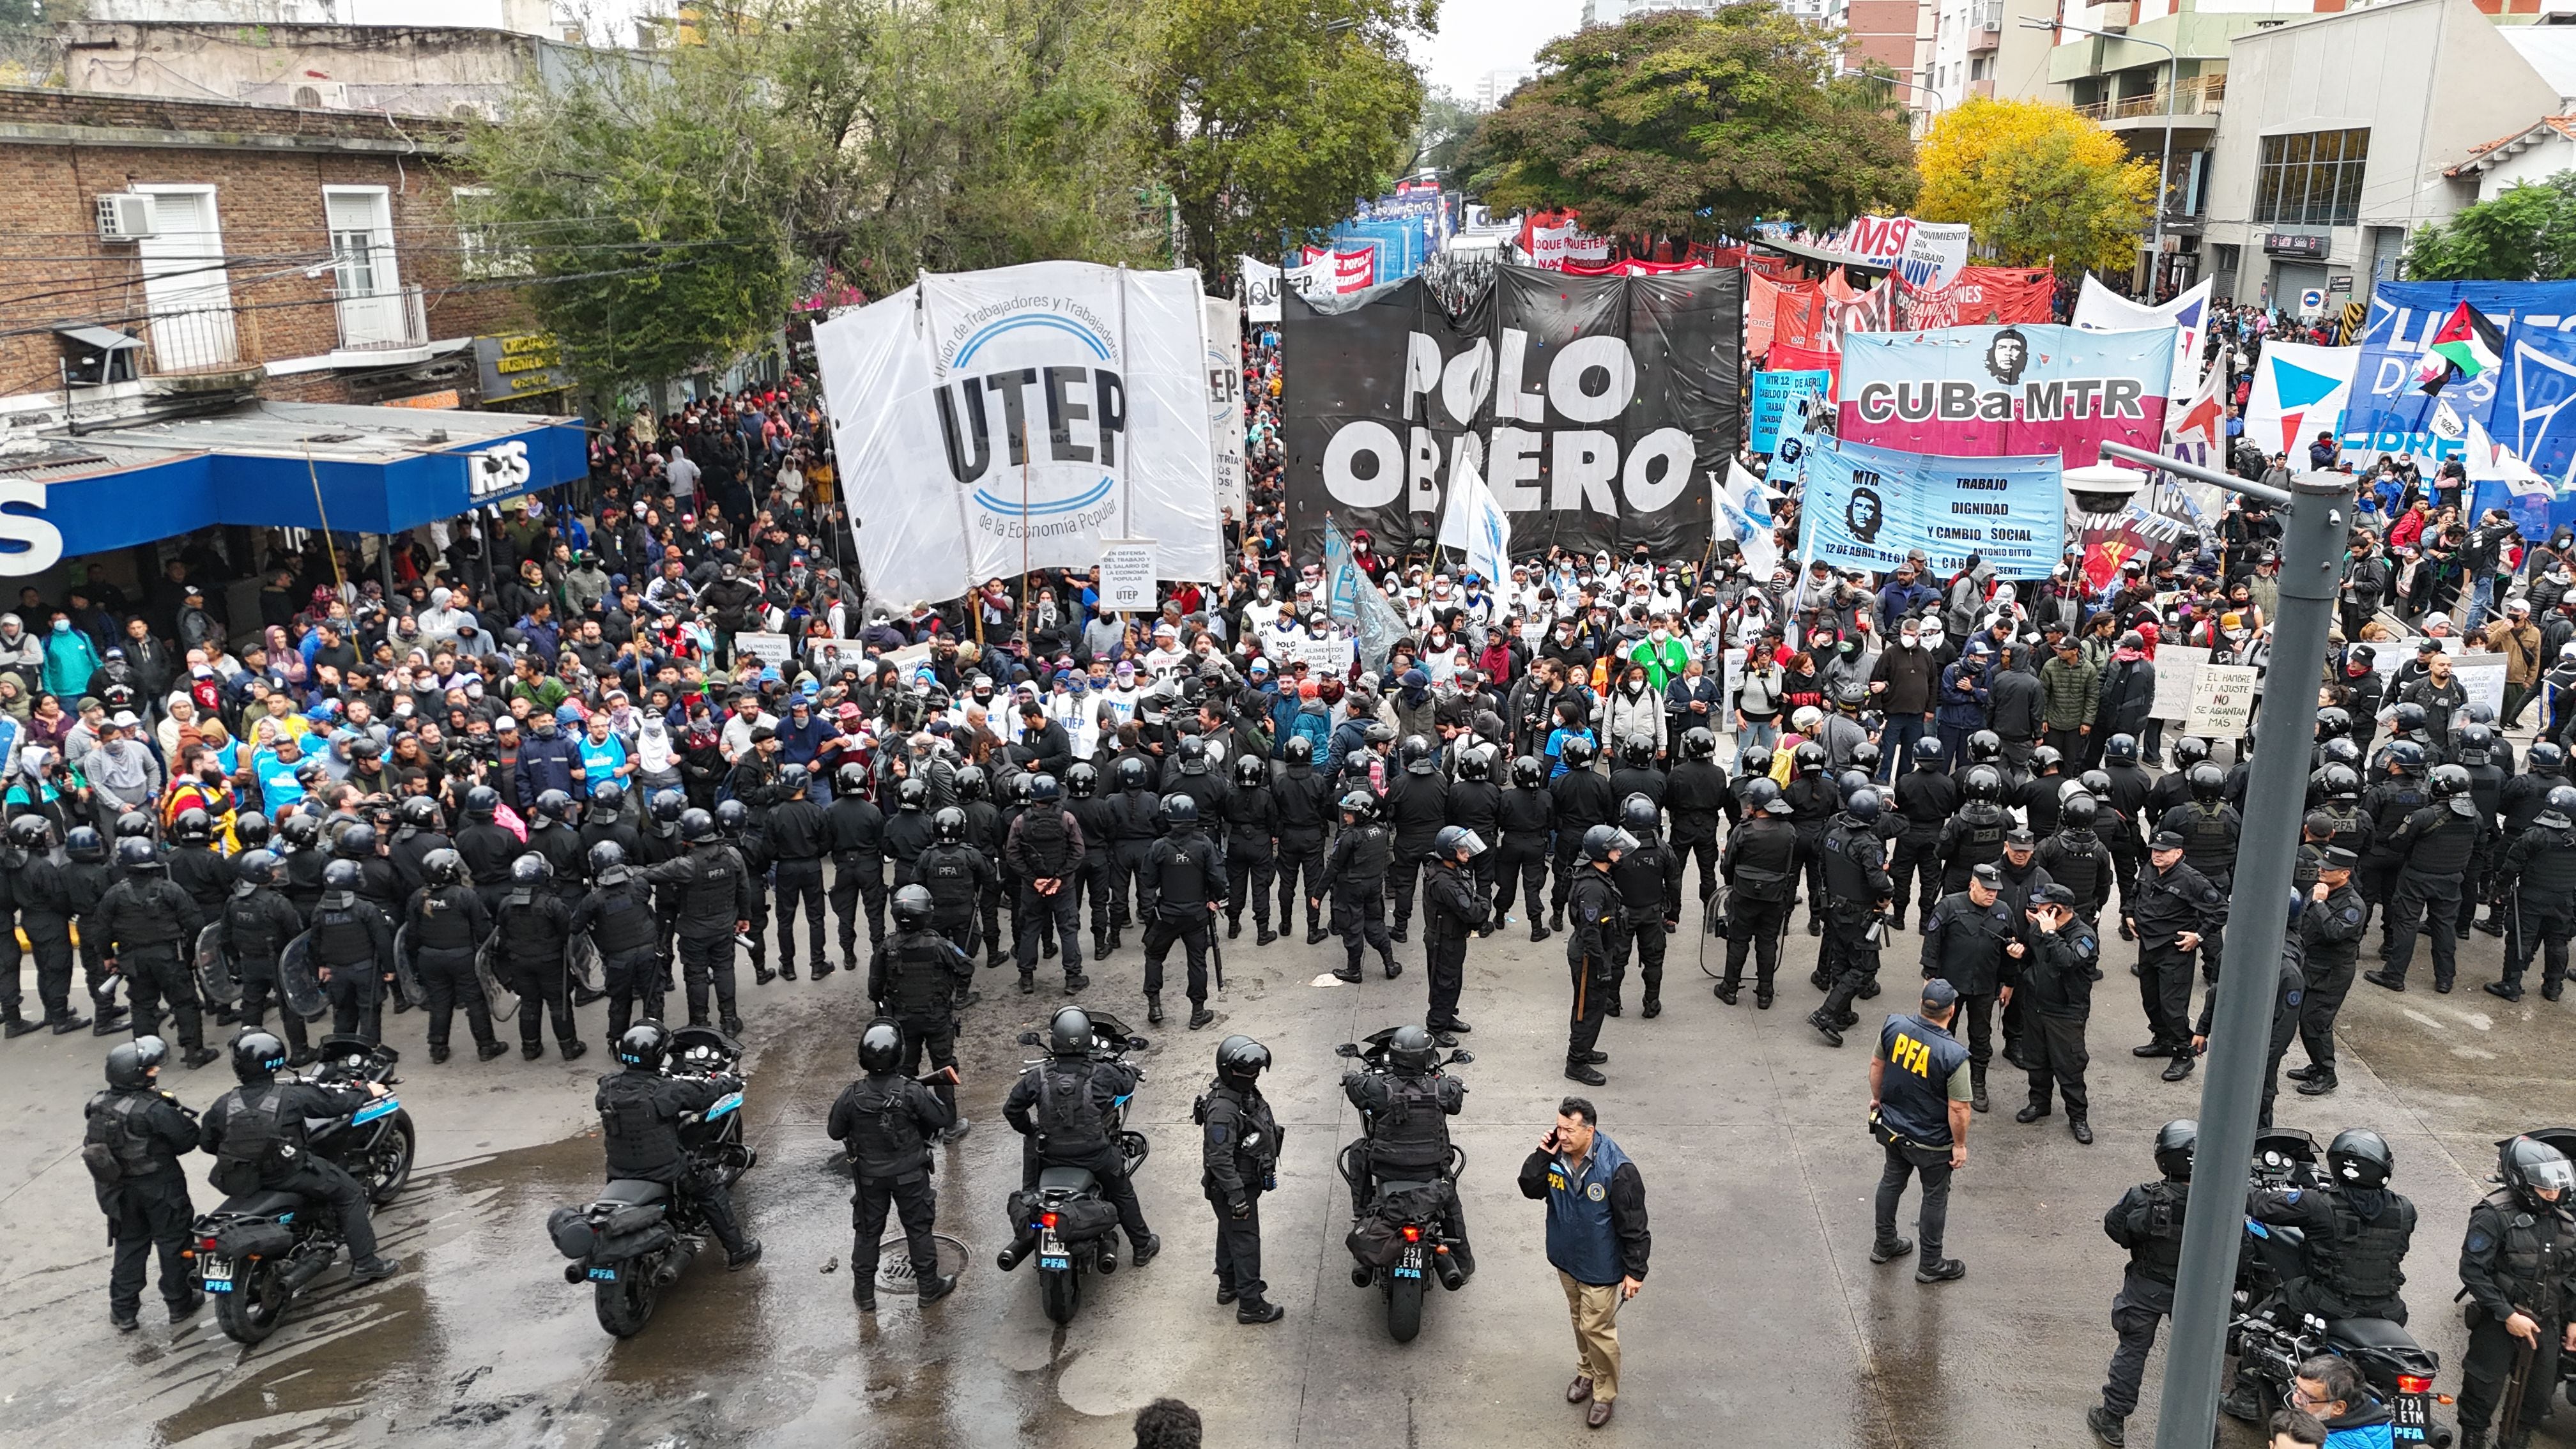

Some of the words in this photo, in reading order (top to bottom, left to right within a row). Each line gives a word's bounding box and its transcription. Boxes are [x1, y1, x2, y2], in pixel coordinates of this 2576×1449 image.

[1918, 231, 1966, 241] MOVIMIENTO
[1914, 238, 1928, 249] SIN
[1910, 250, 1945, 263] TRABAJO
[934, 345, 957, 378] Unión
[954, 324, 969, 341] de
[963, 296, 1048, 326] Trabajadores
[1053, 297, 1061, 311] y
[1064, 297, 1121, 365] Trabajadoras
[1402, 327, 1636, 426] POLO
[1766, 376, 1779, 385] MTR
[1781, 376, 1790, 385] 12
[1795, 378, 1803, 388] DE
[2024, 378, 2145, 421] MTR
[933, 366, 1126, 484] UTEP
[468, 440, 530, 495] RES
[1853, 470, 1880, 487] MTR
[1956, 478, 2007, 491] TRABAJO
[1951, 502, 2009, 516] DIGNIDAD
[979, 512, 992, 530] de
[994, 514, 1005, 536] la
[1927, 526, 1935, 539] Y
[1936, 526, 1982, 541] CAMBIO
[1991, 528, 2032, 542] SOCIAL
[1825, 542, 1836, 554] 12
[1836, 544, 1848, 555] DE
[1848, 546, 1876, 560] ABRIL
[1974, 546, 2007, 558] ANTONIO
[2009, 548, 2032, 557] BITTO
[1116, 590, 1138, 601] UTEP
[1153, 657, 1181, 667] MANHATTA
[2207, 672, 2218, 682] EL
[2222, 673, 2252, 684] HAMBRE
[2204, 684, 2214, 692] EL
[2218, 684, 2250, 694] AJUSTE
[2212, 694, 2230, 706] NO
[2194, 705, 2206, 714] SE
[2209, 707, 2248, 716] AGUANTAN
[1061, 716, 1085, 729] UTEP
[2333, 820, 2352, 830] PFA
[1977, 831, 1997, 841] PFA
[708, 868, 726, 878] PFA
[939, 866, 958, 875] PFA
[621, 1053, 640, 1063] PFA
[1891, 1032, 1931, 1078] PFA
[265, 1057, 284, 1068] PFA
[1547, 1172, 1565, 1191] PFA
[1404, 1246, 1422, 1258] 951
[1041, 1257, 1068, 1268] PFA
[1403, 1257, 1422, 1269] ETM
[588, 1268, 616, 1280] PFA
[1394, 1268, 1421, 1278] PFA
[205, 1280, 231, 1291] PFA
[2400, 1399, 2421, 1412] 791
[2400, 1411, 2425, 1424] ETM
[2393, 1427, 2425, 1440] PFA
